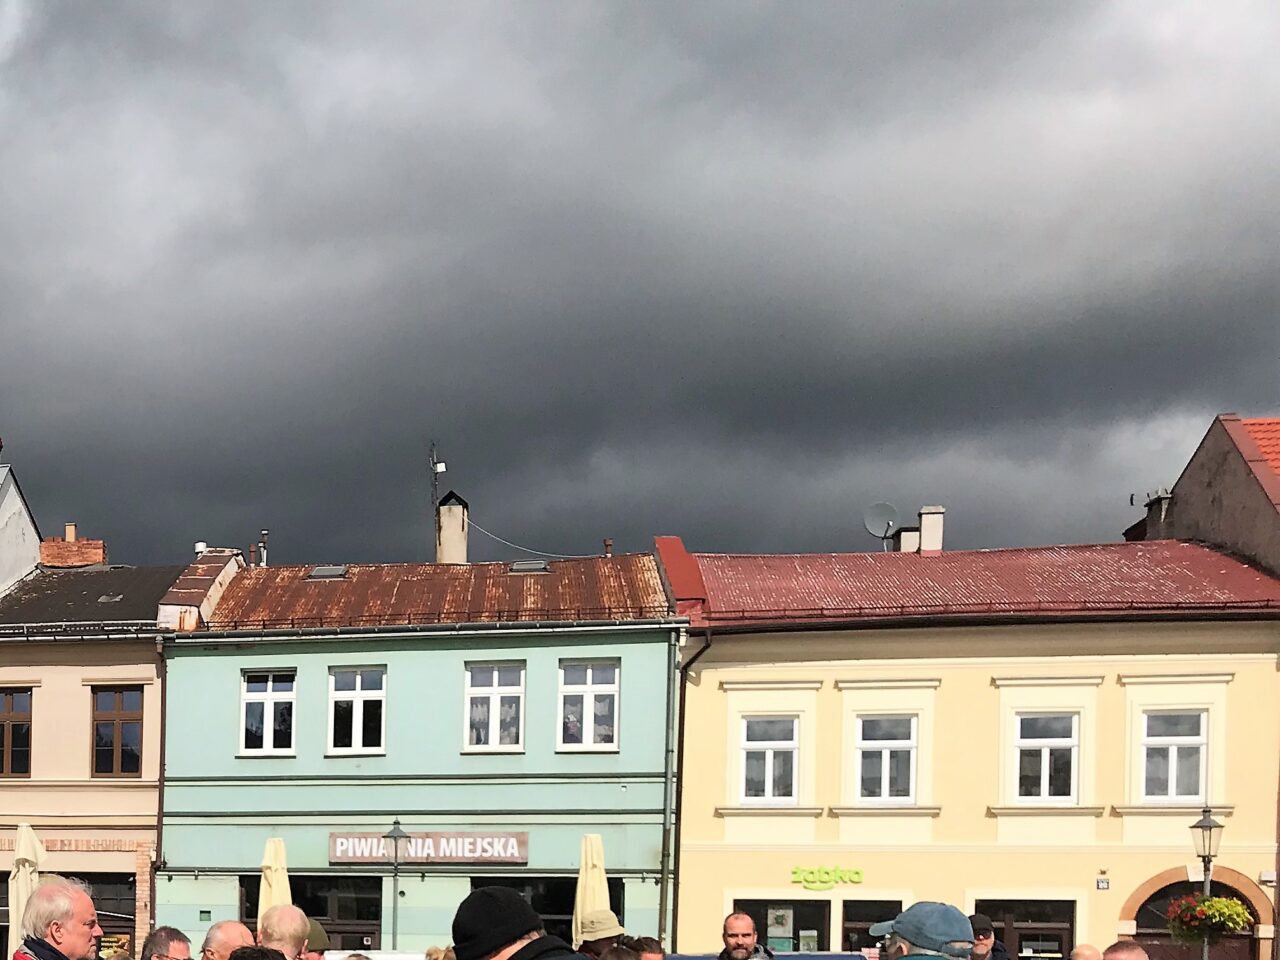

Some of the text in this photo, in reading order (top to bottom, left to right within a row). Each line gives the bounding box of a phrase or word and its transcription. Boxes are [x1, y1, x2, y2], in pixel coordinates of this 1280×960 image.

[336, 837, 520, 857] PIWIANIA MIEJSKA
[791, 866, 863, 884] żabka
